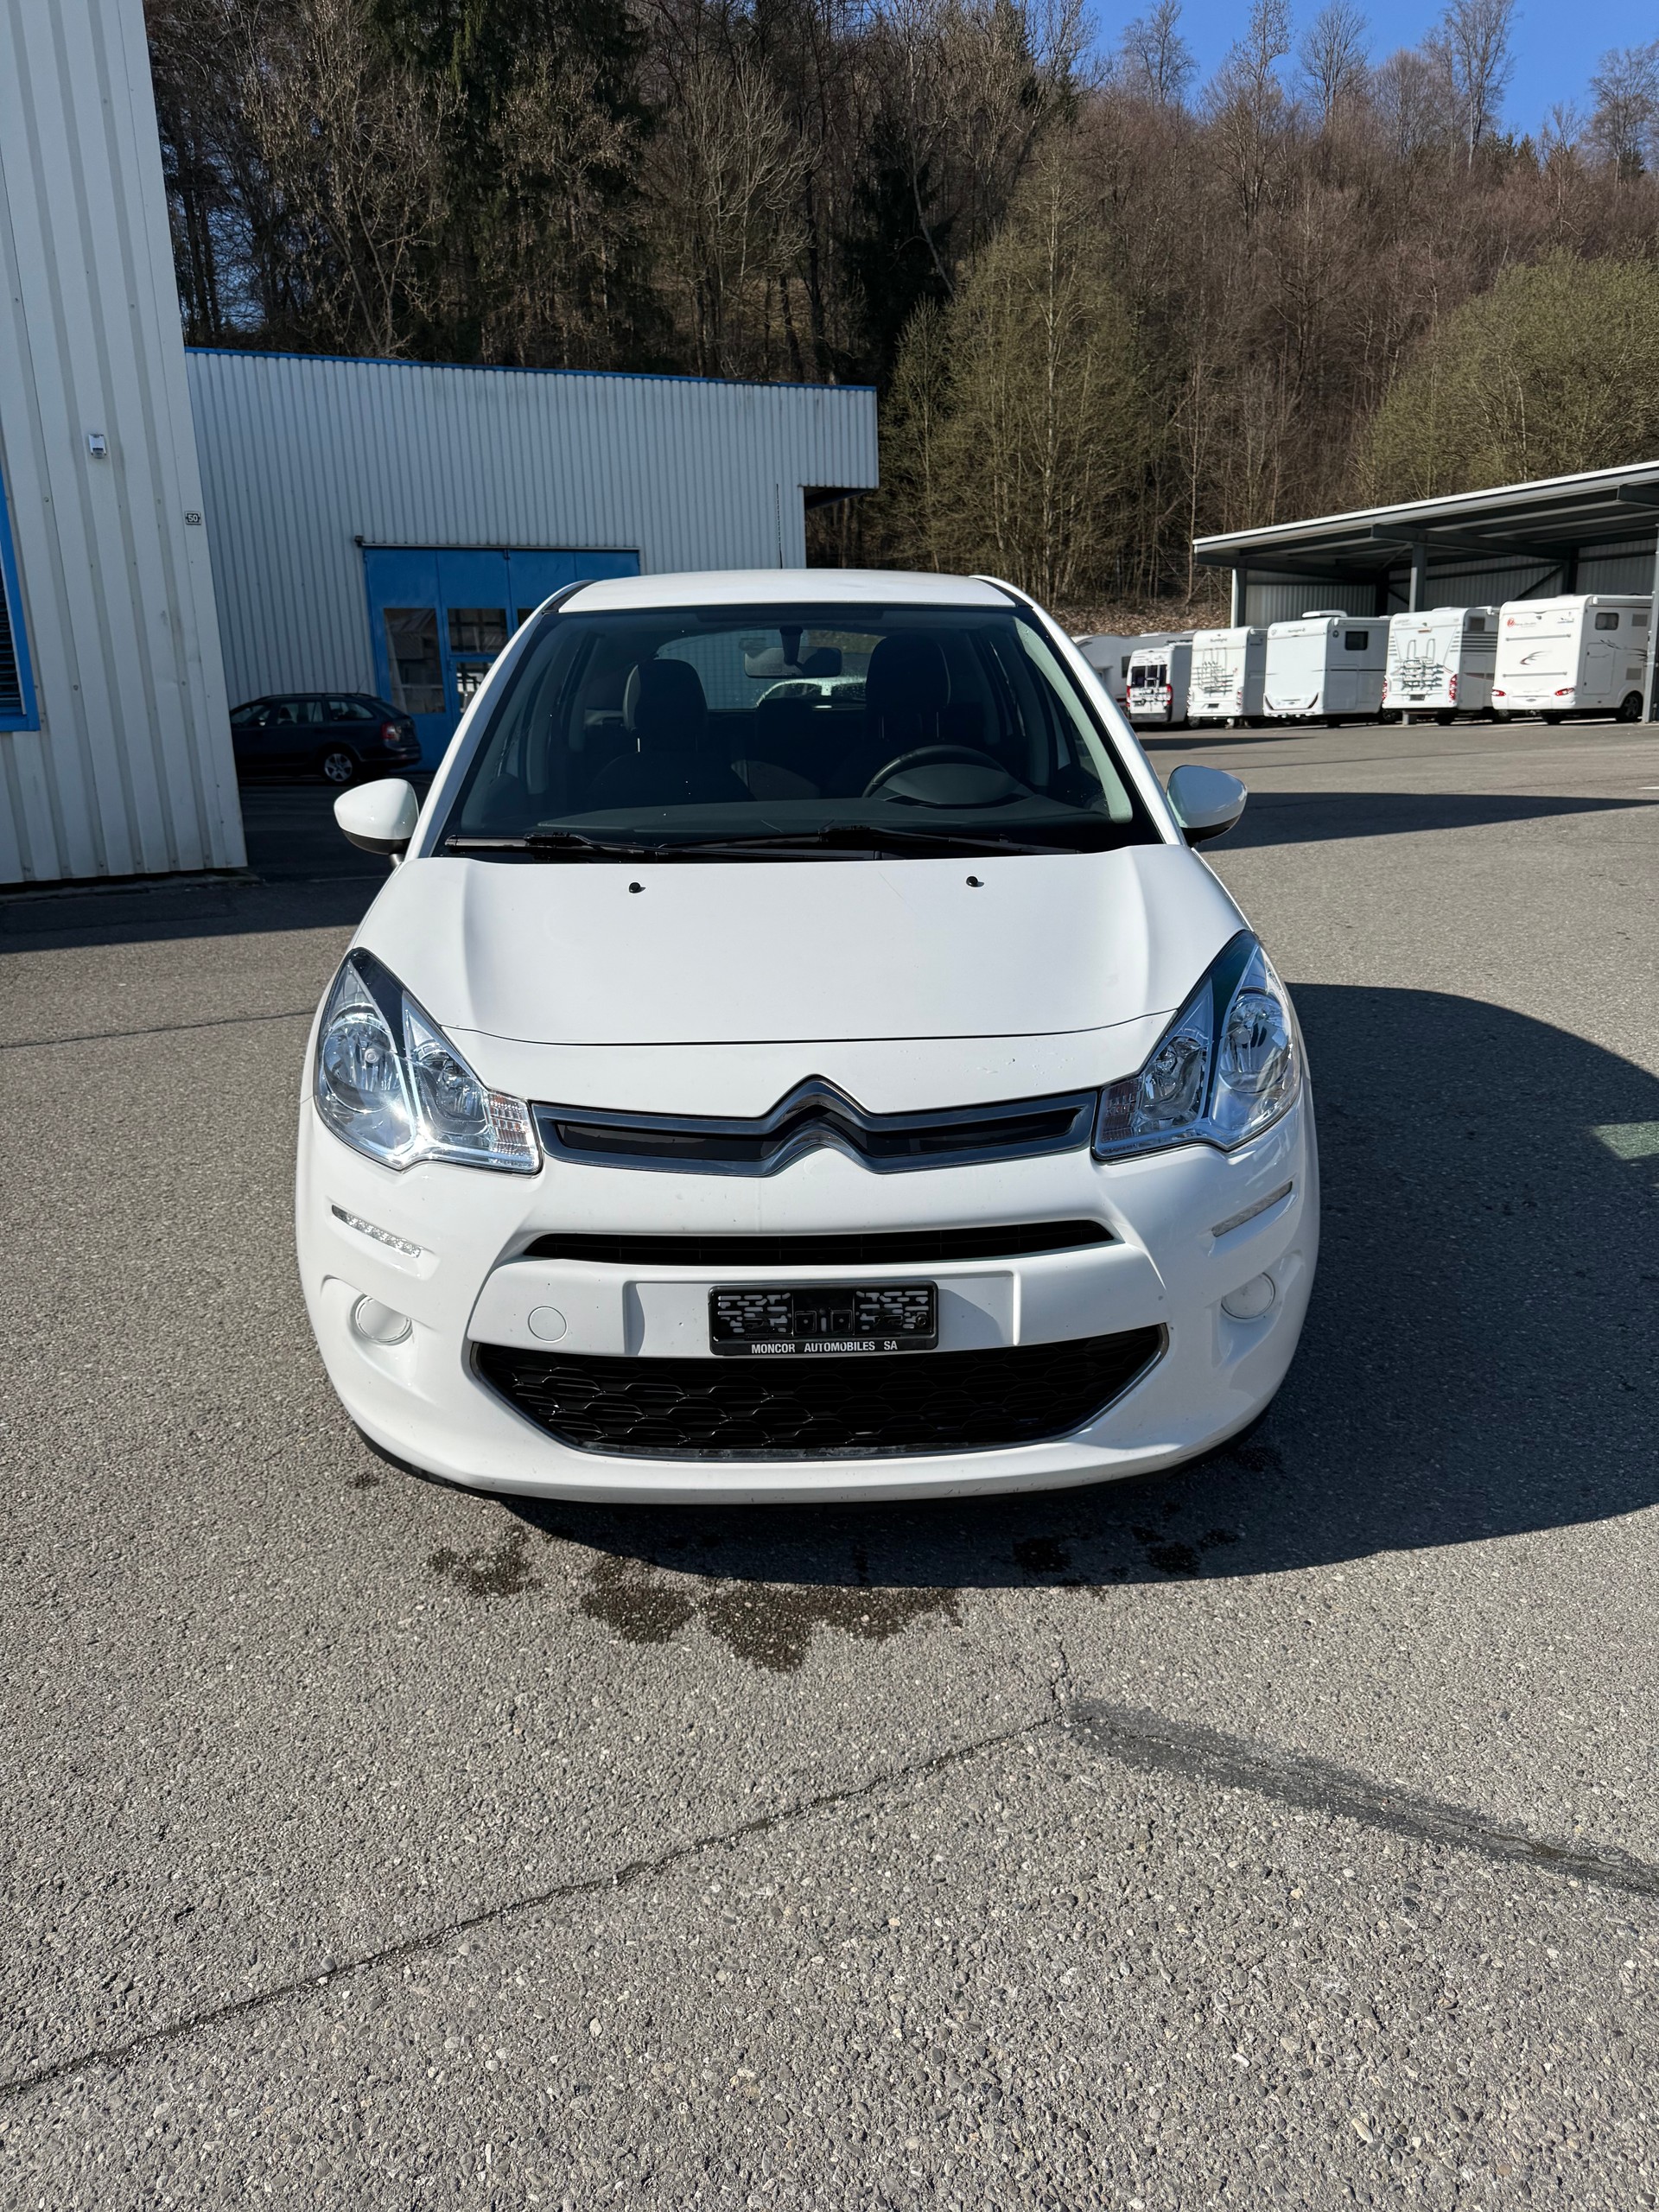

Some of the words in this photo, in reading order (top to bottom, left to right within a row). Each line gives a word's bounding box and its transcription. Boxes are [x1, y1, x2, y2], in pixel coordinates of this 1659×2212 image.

[751, 1343, 796, 1354] MONCOR
[804, 1341, 875, 1352] AUTOMOBILES
[883, 1340, 898, 1351] SA
